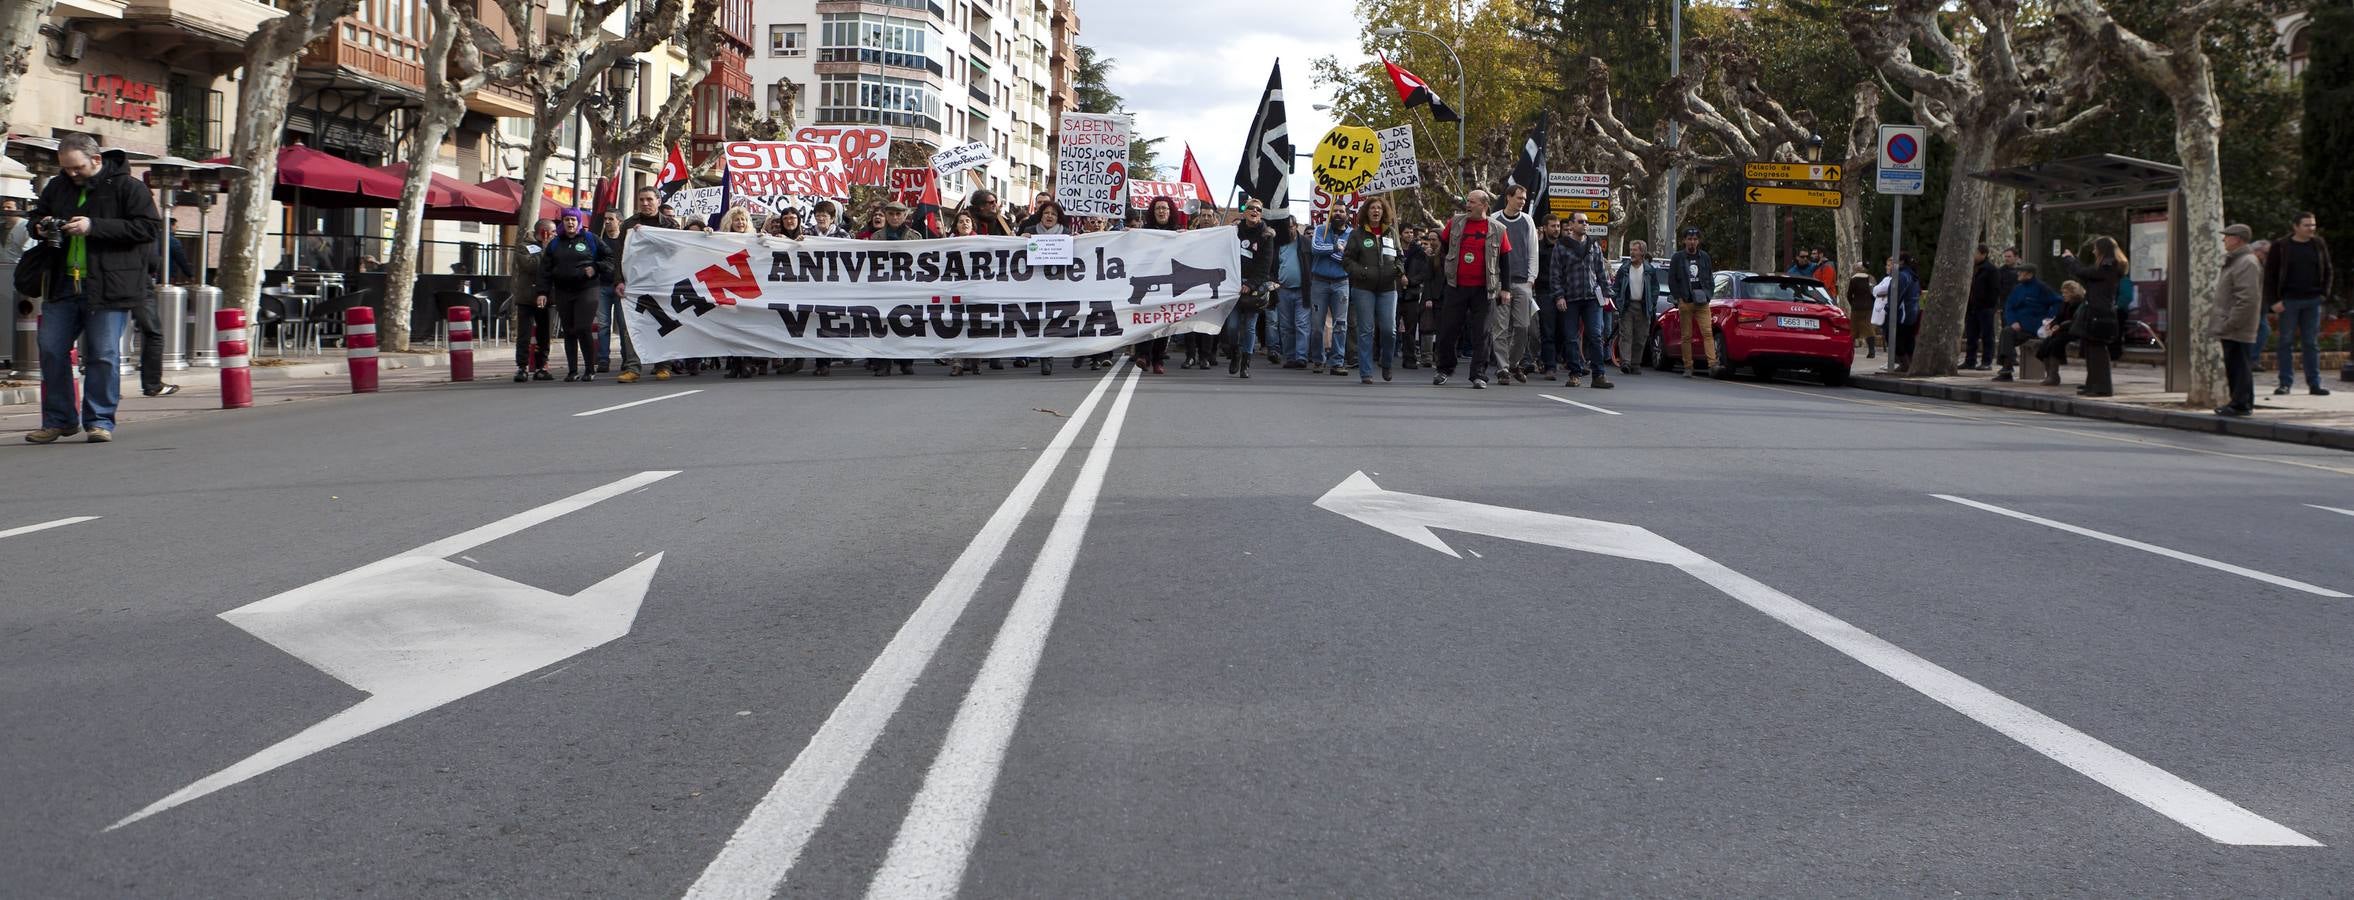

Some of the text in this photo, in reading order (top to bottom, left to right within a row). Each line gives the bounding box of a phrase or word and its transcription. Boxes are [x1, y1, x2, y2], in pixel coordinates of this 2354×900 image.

[1064, 119, 1113, 132] SABEN
[1392, 127, 1407, 137] DE
[1062, 134, 1126, 147] VUESTROS
[1324, 131, 1374, 154] NO a la
[727, 142, 837, 170] STOP
[1329, 155, 1359, 170] LEY
[1385, 151, 1398, 160] LOS
[730, 166, 849, 197] REPRESIÓN
[1060, 172, 1120, 185] HACIENDO
[1313, 164, 1372, 192] MORDAZA
[1375, 181, 1385, 190] LA
[1391, 175, 1418, 187] RIOJA
[1059, 188, 1108, 199] CON LOS
[1132, 181, 1194, 199] STOP
[1058, 199, 1123, 215] NUESTROS
[768, 250, 1028, 282] ANIVERSARIO
[1095, 247, 1126, 281] la
[1160, 303, 1195, 312] STOP
[768, 296, 1124, 339] VERGÜENZA
[1133, 312, 1198, 324] REPRES
